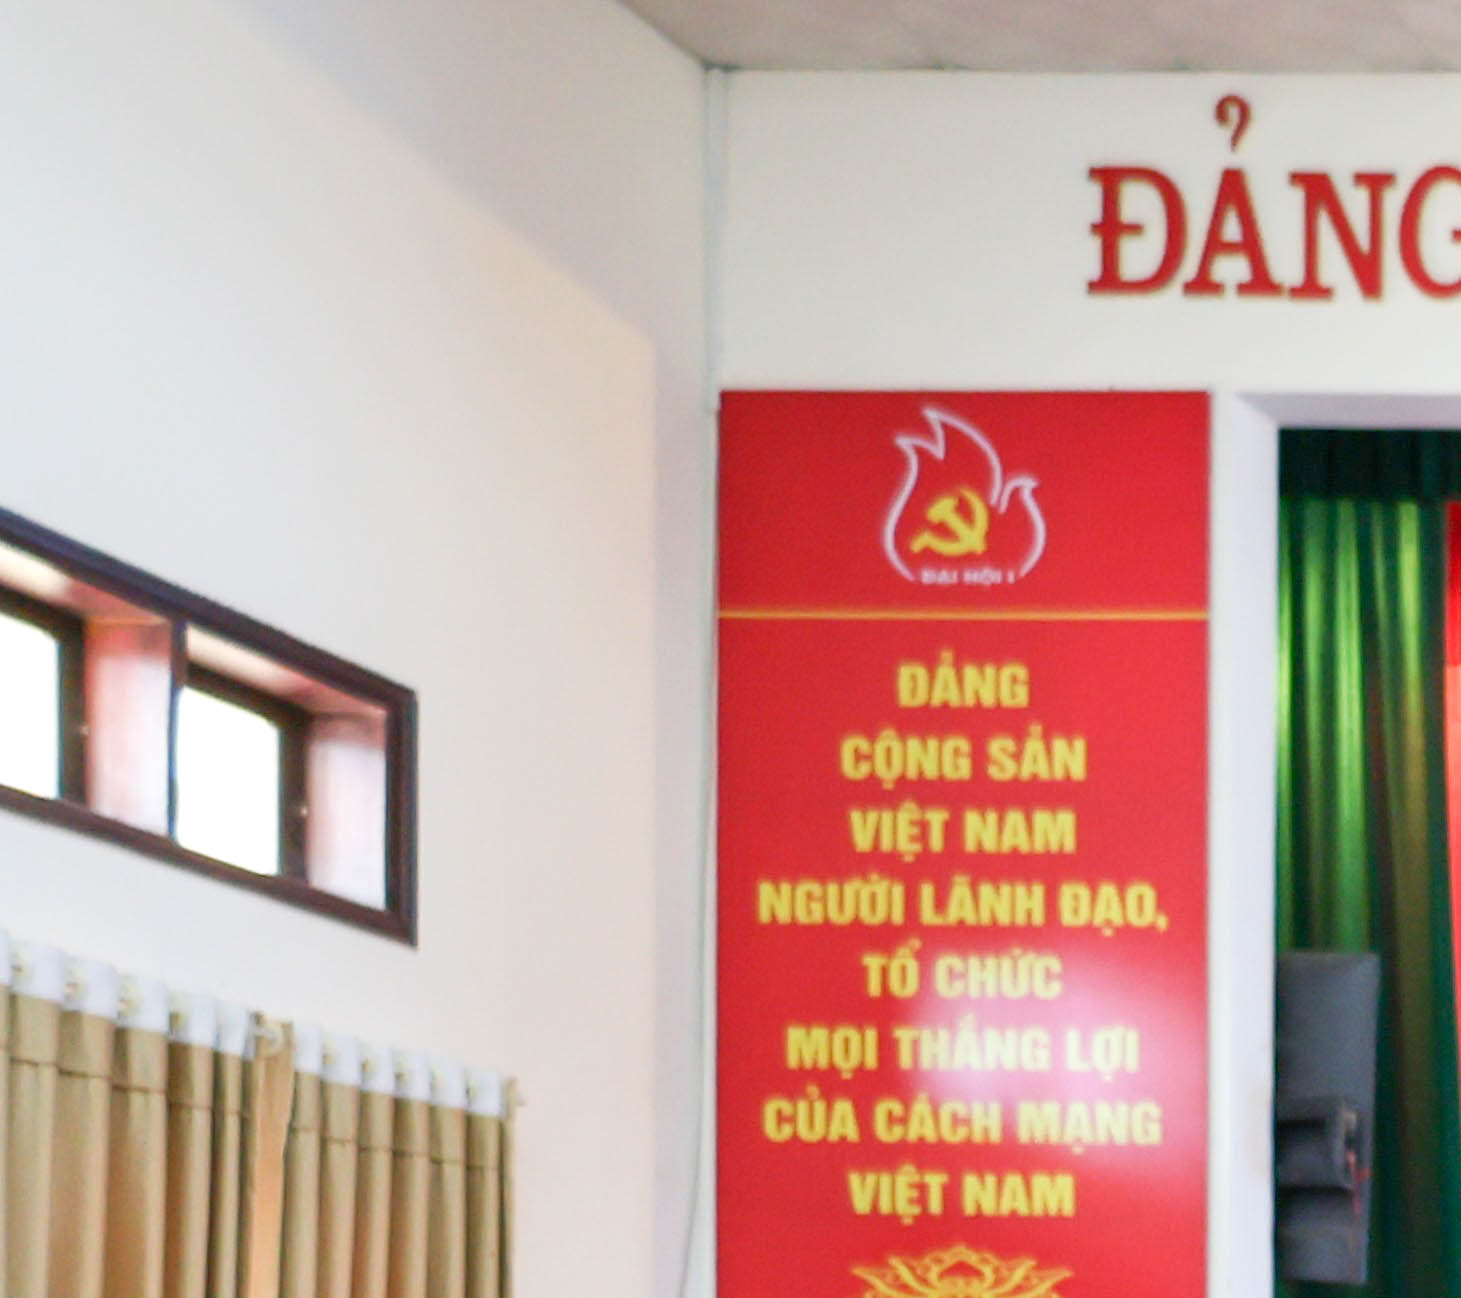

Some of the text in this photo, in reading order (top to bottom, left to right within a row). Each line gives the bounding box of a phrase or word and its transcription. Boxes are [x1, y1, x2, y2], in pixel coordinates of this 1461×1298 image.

[897, 646, 1029, 708] ĐẢNG
[840, 723, 1087, 790] CỘNG SẢN
[850, 800, 1077, 862] VIỆT NAM
[758, 872, 1169, 937] NGƯỜI LÃNH ĐẠO,
[862, 936, 1064, 1000] TỔ CHỨC
[787, 1011, 1140, 1082] MỌI THẮNG LỢI
[763, 1083, 1164, 1156] CỦA CÁCH MẠNG
[848, 1162, 1076, 1224] VIỆT NAM
